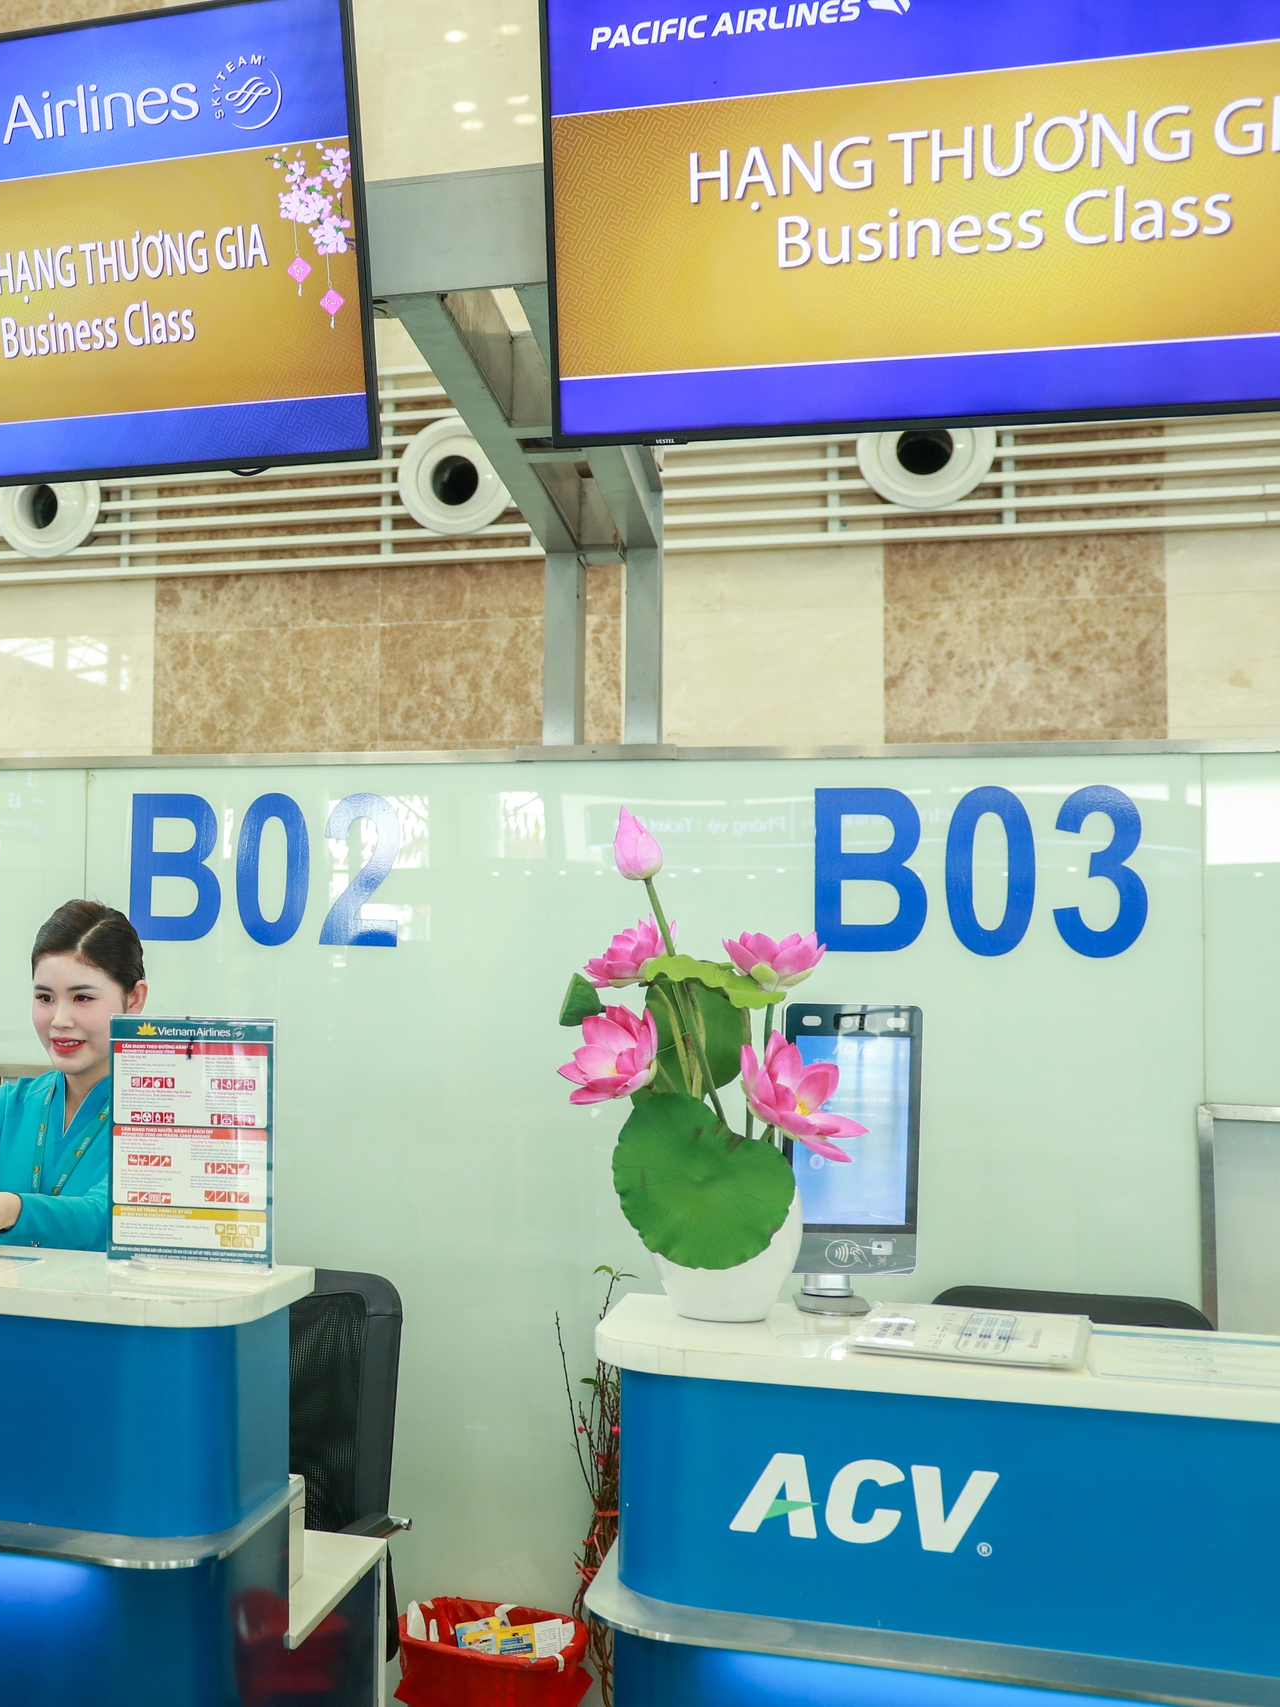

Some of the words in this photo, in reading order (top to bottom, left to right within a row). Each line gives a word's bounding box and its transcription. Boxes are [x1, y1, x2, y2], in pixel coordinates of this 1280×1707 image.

[590, 14, 709, 51] PACIFIC
[711, 0, 862, 36] AIRLINES
[4, 82, 199, 145] Airlines
[689, 135, 875, 212] HẠNG
[888, 105, 1193, 186] THƯƠNG
[79, 230, 209, 284] THƯƠNG
[214, 224, 268, 270] GIA
[777, 207, 1043, 270] Business
[1065, 185, 1232, 245] Class
[1, 311, 119, 359] Business
[124, 302, 196, 345] Class
[129, 792, 398, 947] B02
[814, 785, 1149, 958] B03
[158, 1026, 196, 1036] Vietnam
[196, 1027, 231, 1037] Airlines
[729, 1452, 1000, 1554] ACV
